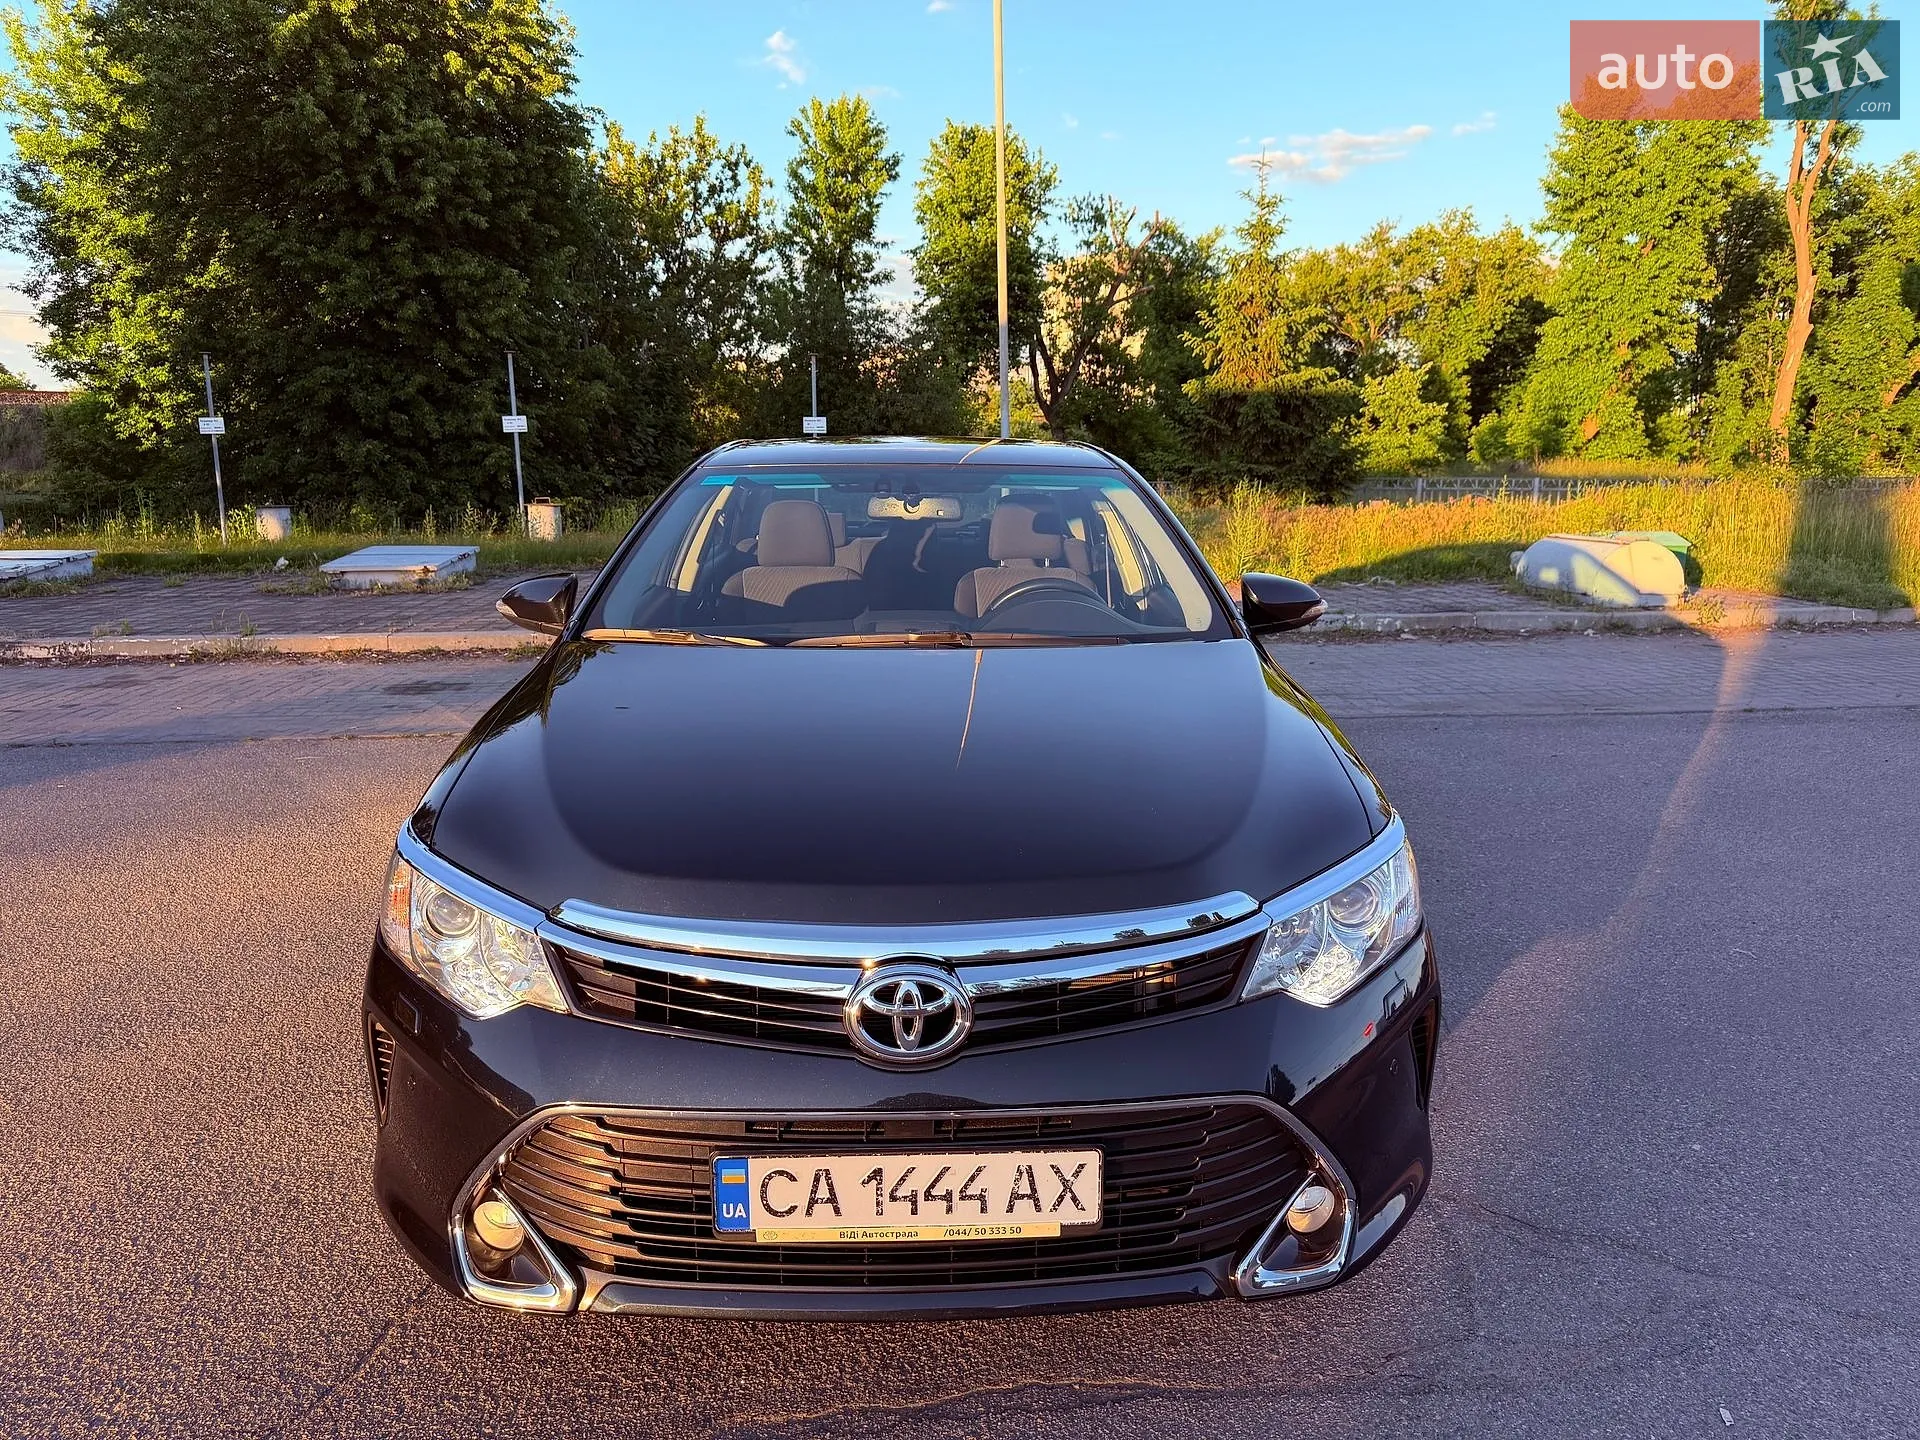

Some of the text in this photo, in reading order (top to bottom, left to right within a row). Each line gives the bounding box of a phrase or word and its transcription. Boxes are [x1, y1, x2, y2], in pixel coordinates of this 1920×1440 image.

[758, 1162, 1088, 1218] CA 1444 AX
[722, 1202, 747, 1219] UA
[839, 1230, 919, 1240] ВіДі Автострада
[943, 1226, 1022, 1237] /044/ 50 333 50
